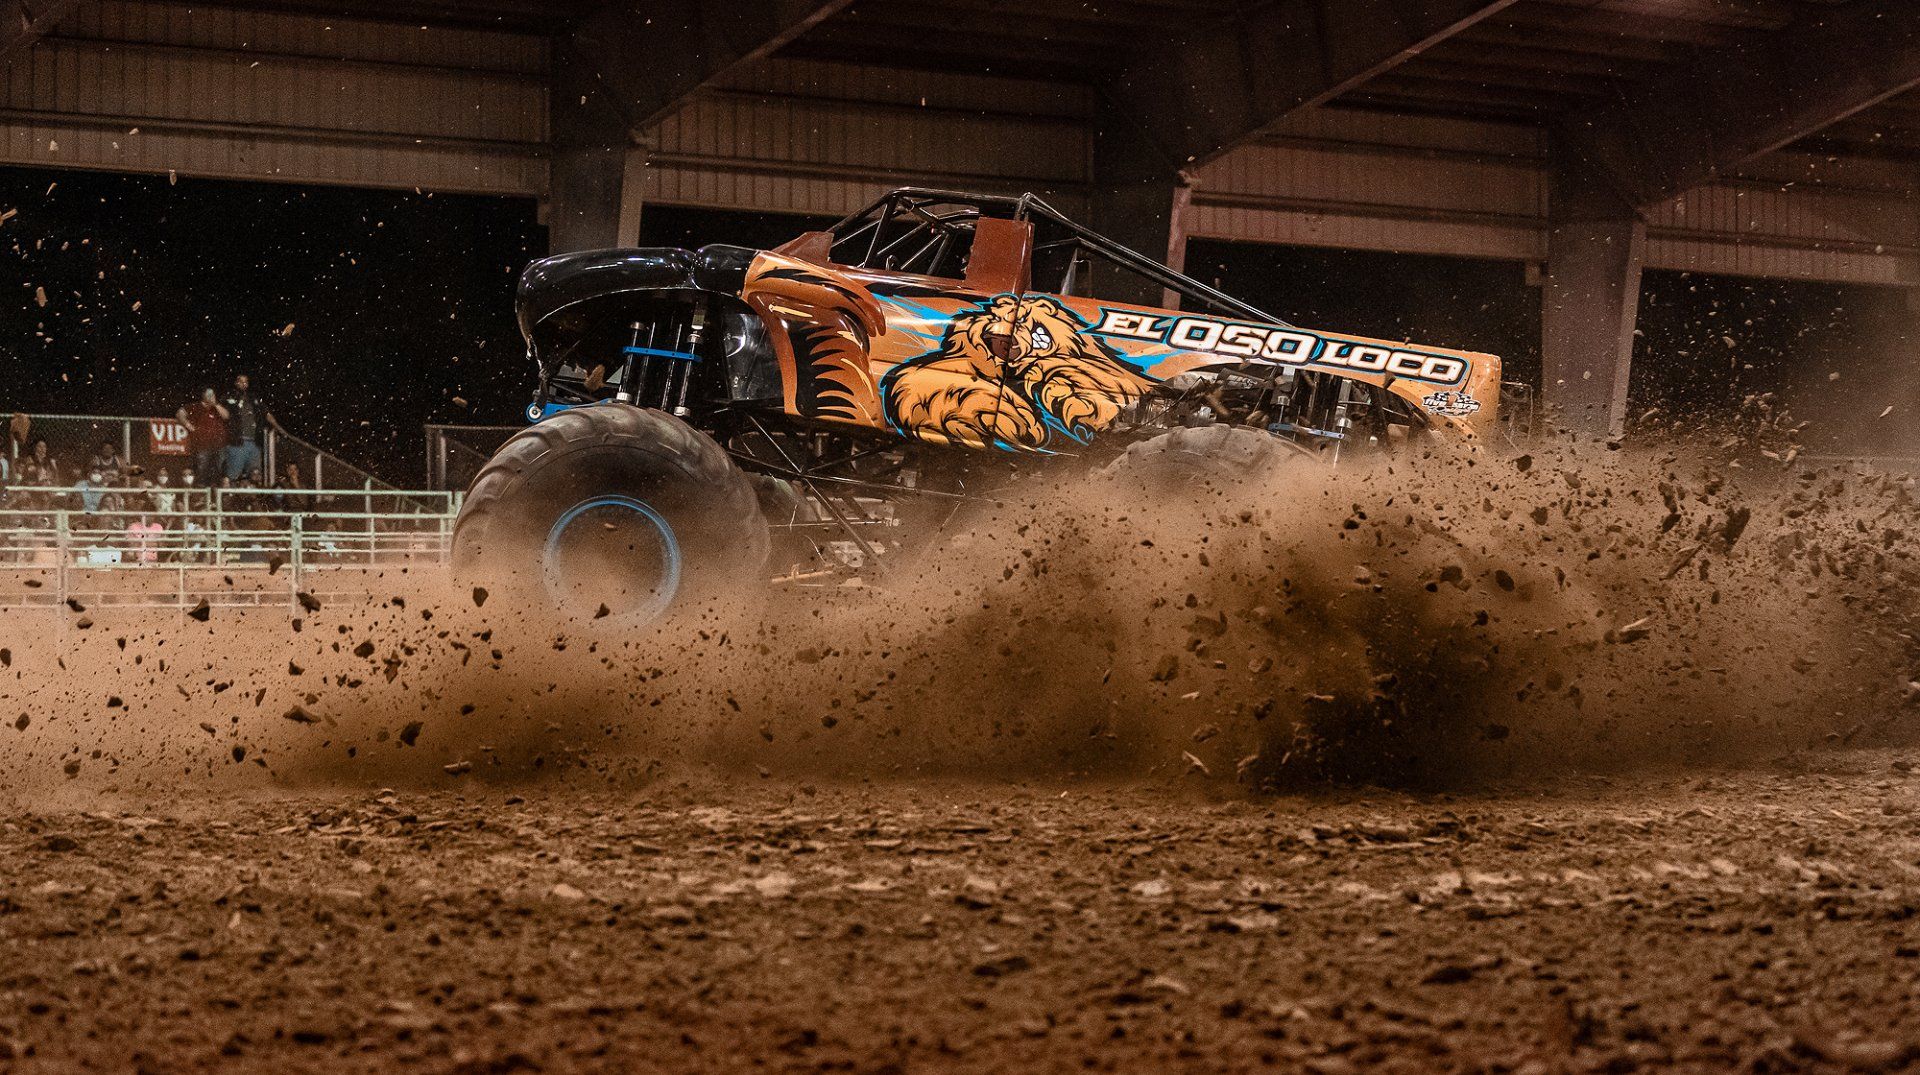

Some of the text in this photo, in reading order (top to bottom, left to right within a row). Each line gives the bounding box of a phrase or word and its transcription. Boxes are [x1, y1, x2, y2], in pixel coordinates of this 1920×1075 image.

[1099, 311, 1464, 382] EL OSO LOCO
[151, 423, 189, 442] VIP
